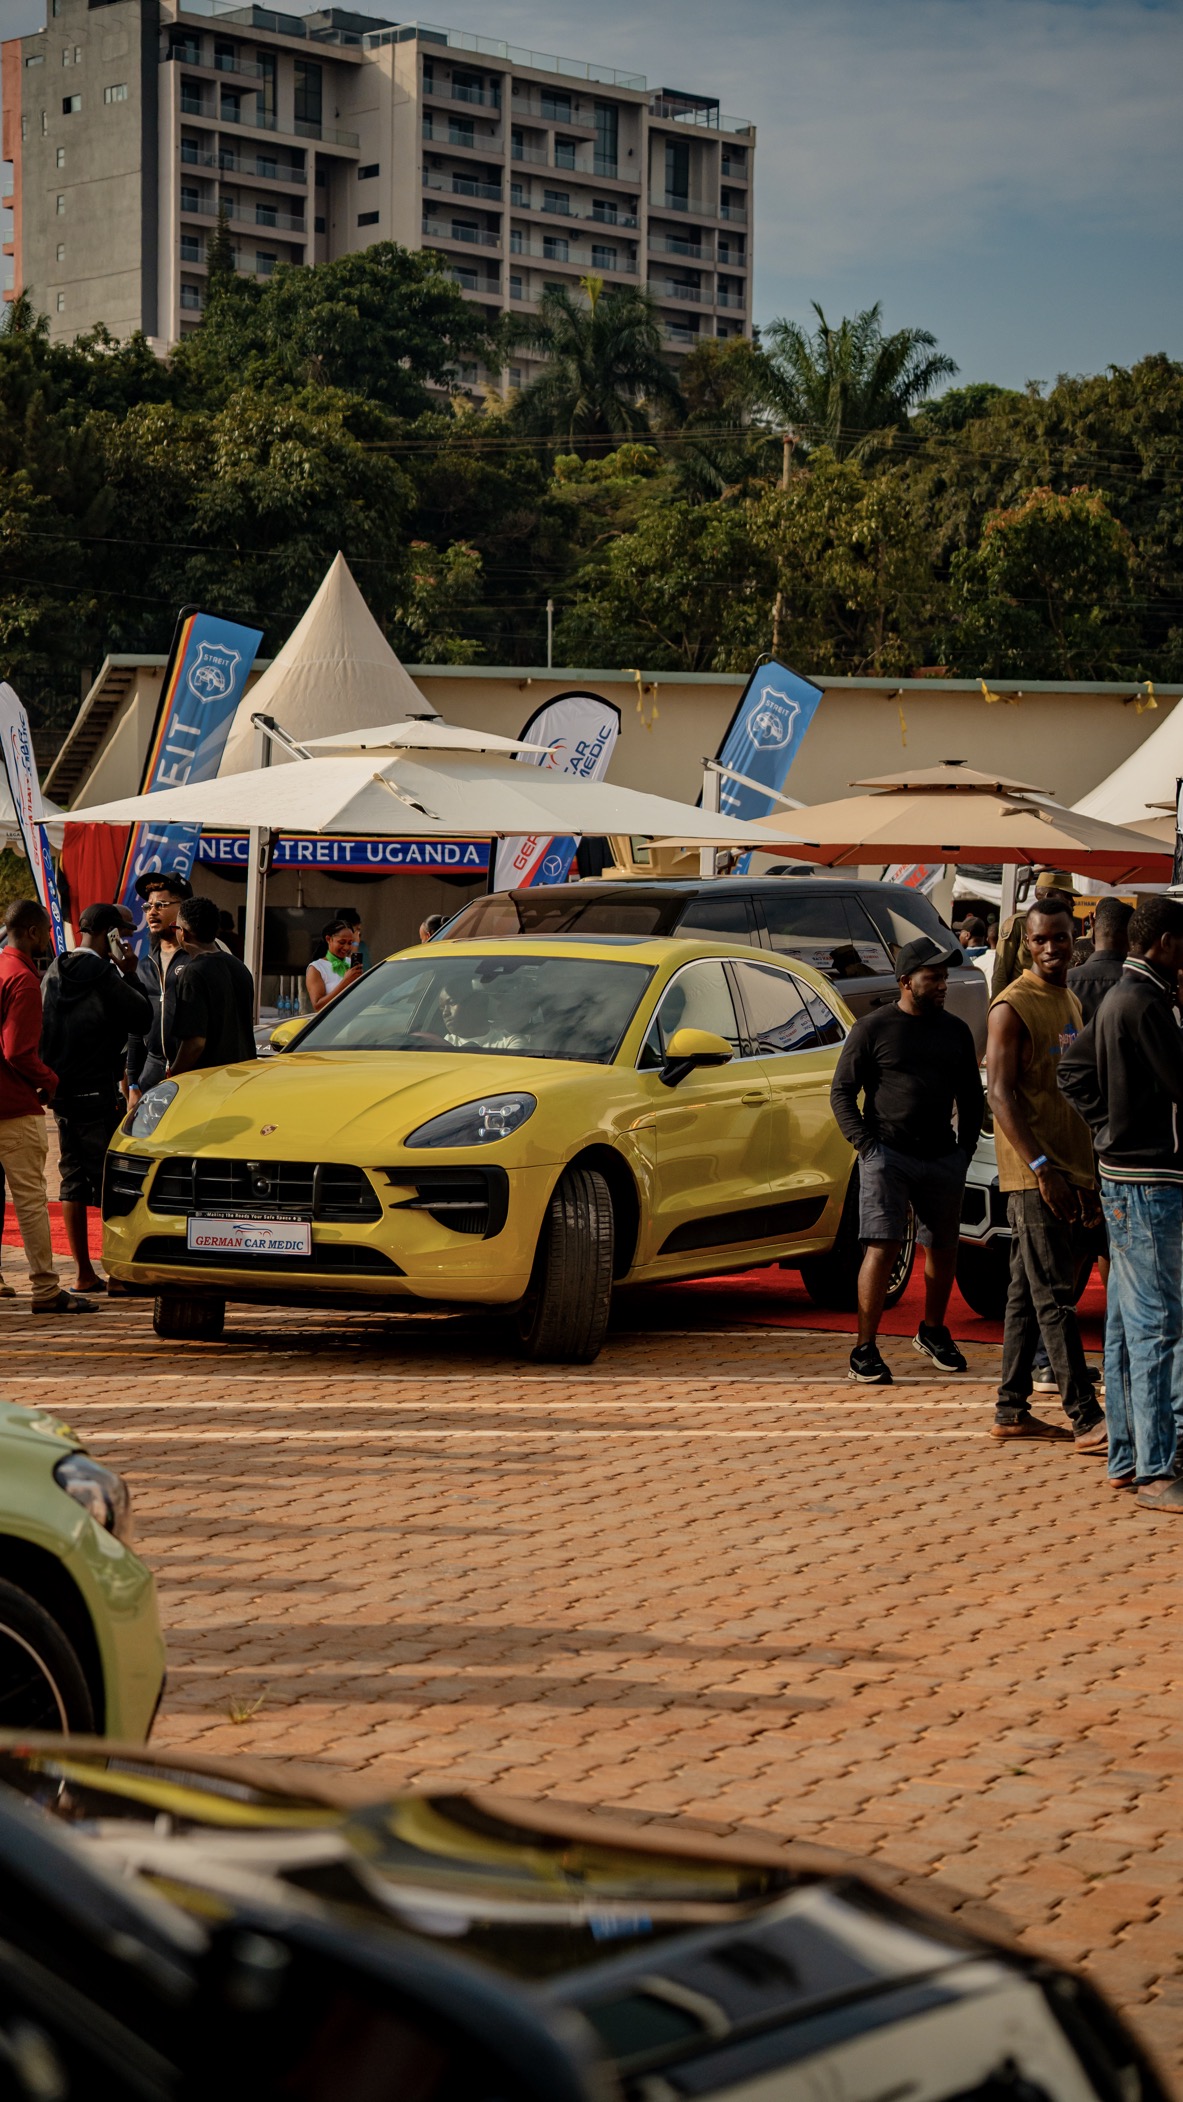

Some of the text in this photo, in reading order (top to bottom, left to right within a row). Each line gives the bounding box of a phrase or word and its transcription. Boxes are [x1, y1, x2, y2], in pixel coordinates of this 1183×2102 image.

[203, 653, 230, 667] STREIT
[765, 699, 790, 717] STREIT
[200, 839, 480, 864] NEC TREIT UGANDA
[513, 835, 539, 871] GER
[195, 1236, 304, 1250] GERMAN CAR MEDIC
